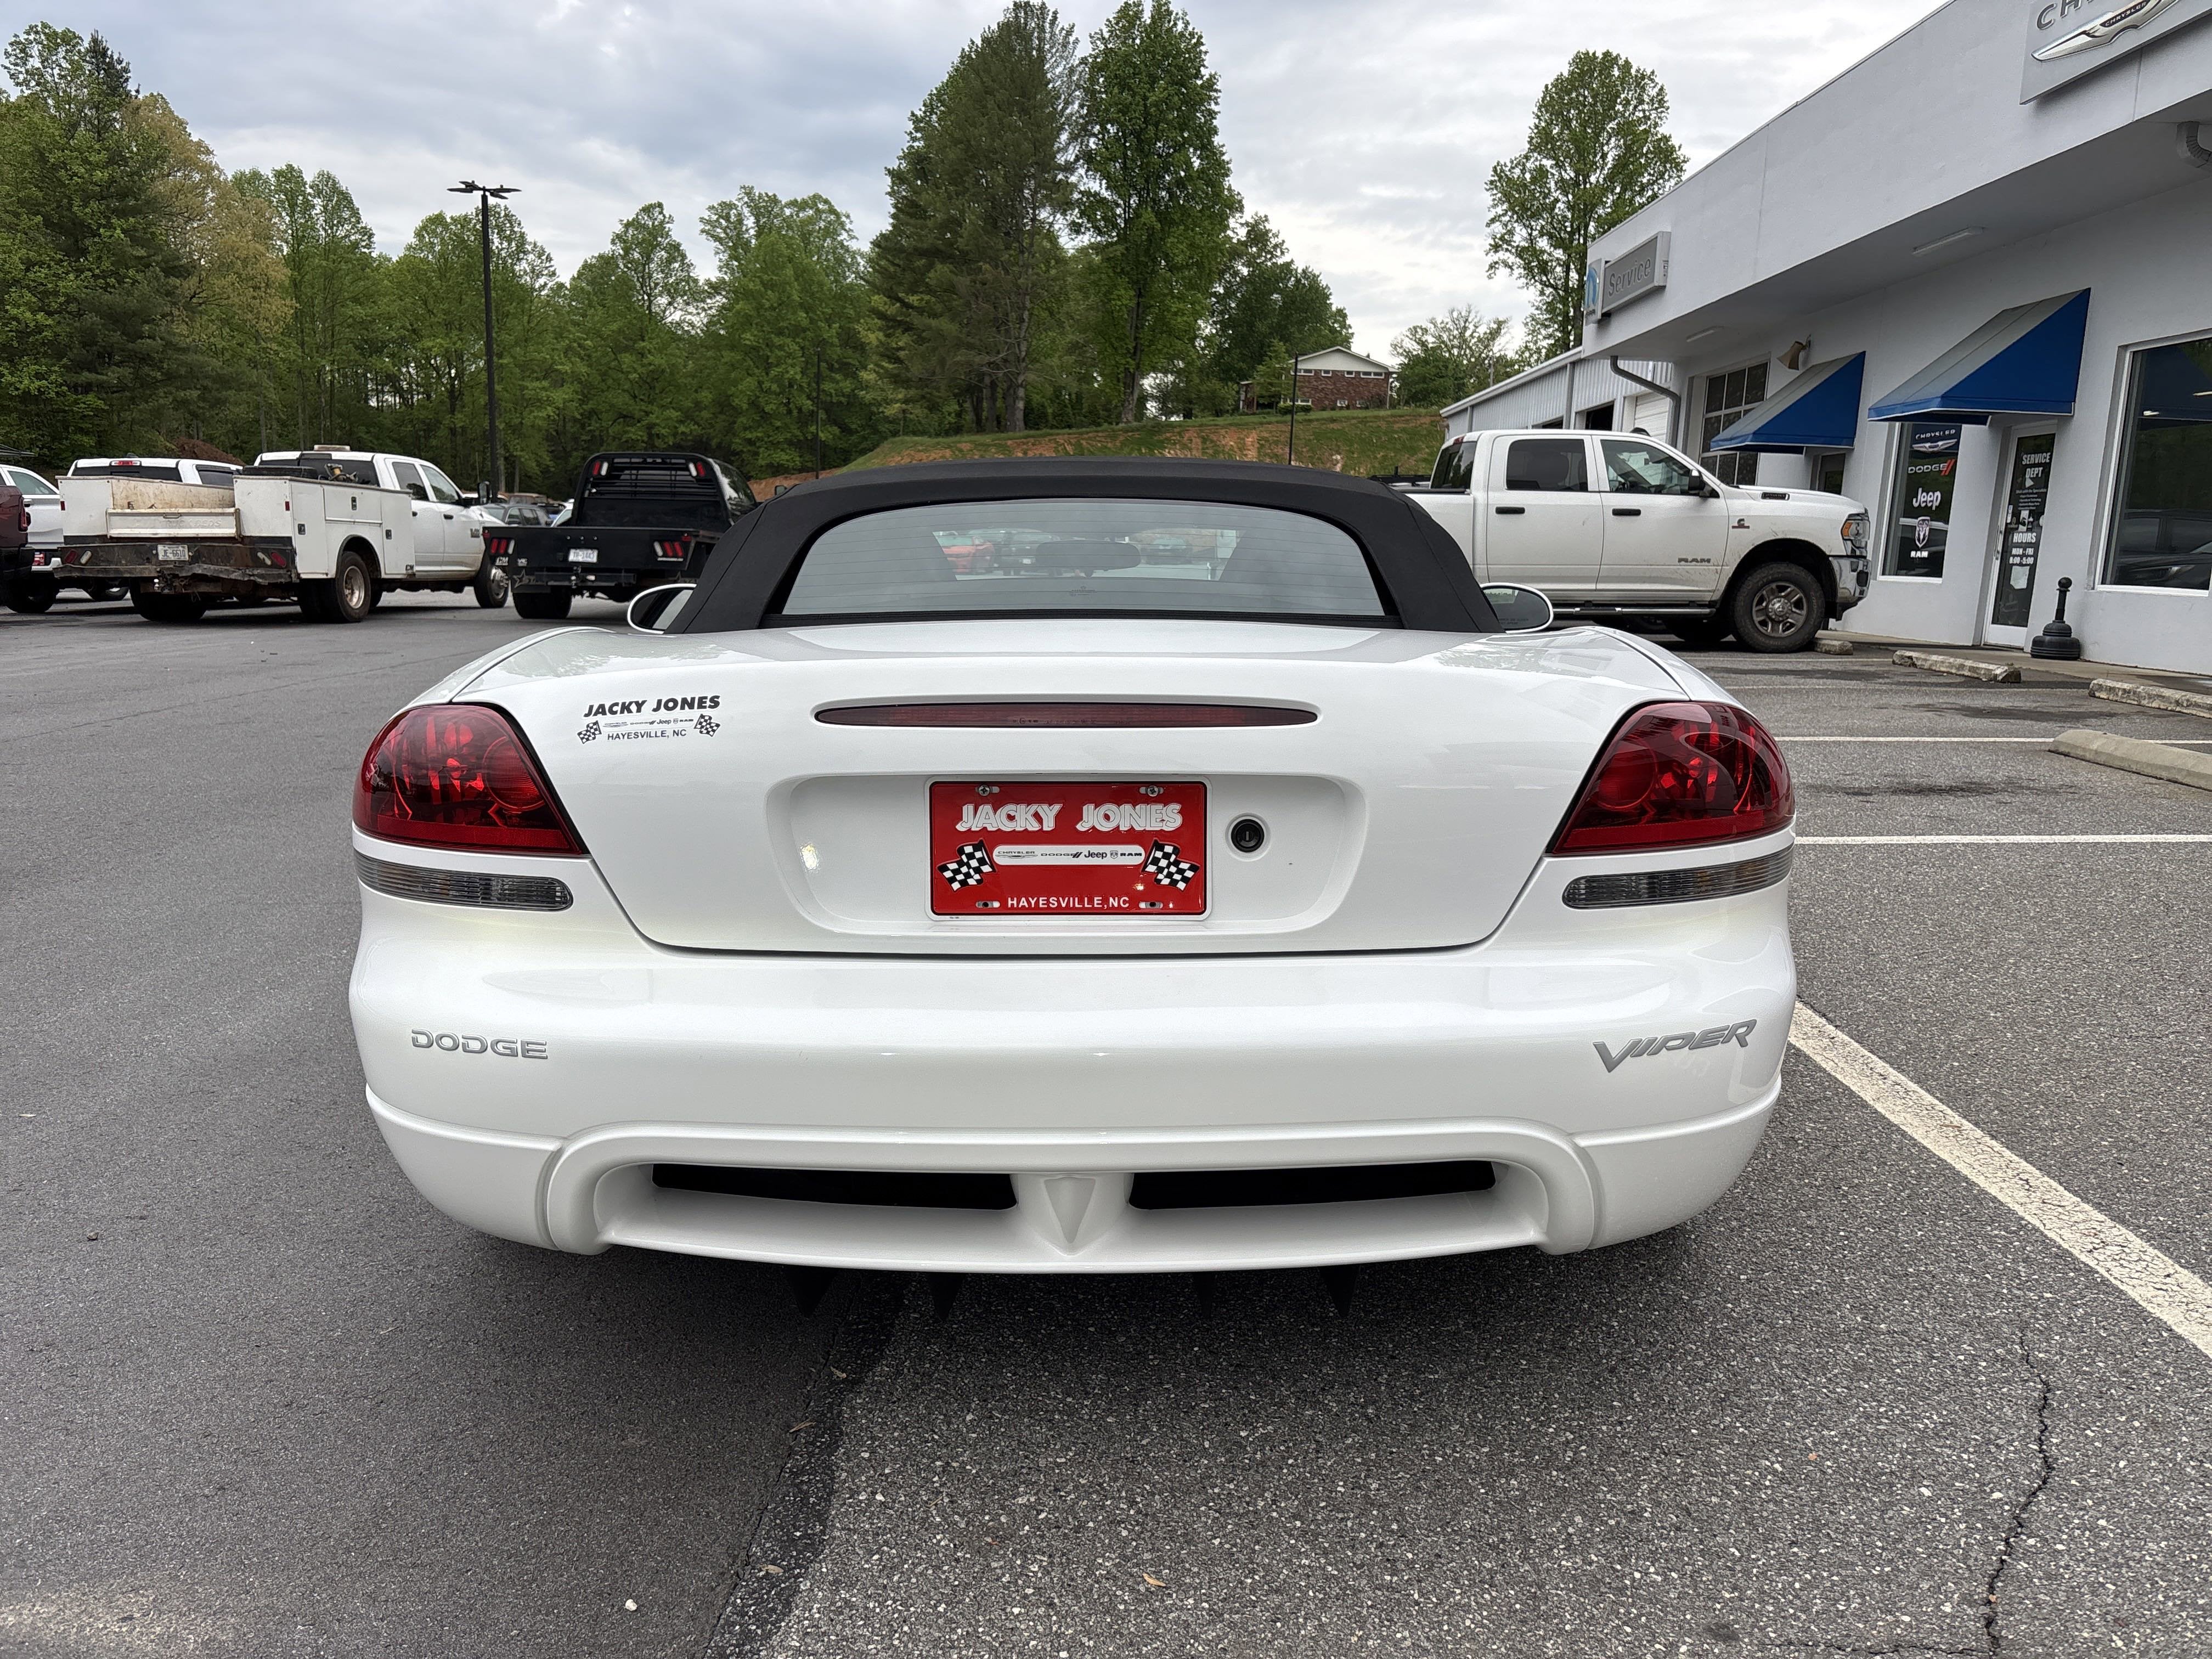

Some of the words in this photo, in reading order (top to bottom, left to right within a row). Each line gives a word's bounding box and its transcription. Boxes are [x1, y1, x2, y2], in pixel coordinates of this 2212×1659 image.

[2104, 1, 2147, 26] CHRYSLER
[1609, 258, 1651, 297] Service
[1908, 463, 1948, 473] DODGE
[2022, 452, 2051, 465] SERVICE
[2025, 467, 2043, 478] DEPT
[1912, 487, 1941, 510] Jeep
[2013, 532, 2036, 543] HOURS
[583, 699, 647, 718] JACKY
[651, 695, 721, 713] JONES
[607, 730, 669, 741] HAYESVILLE,
[673, 729, 687, 737] NC
[956, 803, 1063, 831] JACKY
[1076, 803, 1183, 831] JONES
[1084, 850, 1108, 860] Jeep
[411, 1028, 548, 1059] DODGE
[1593, 1019, 1757, 1073] VIPER
